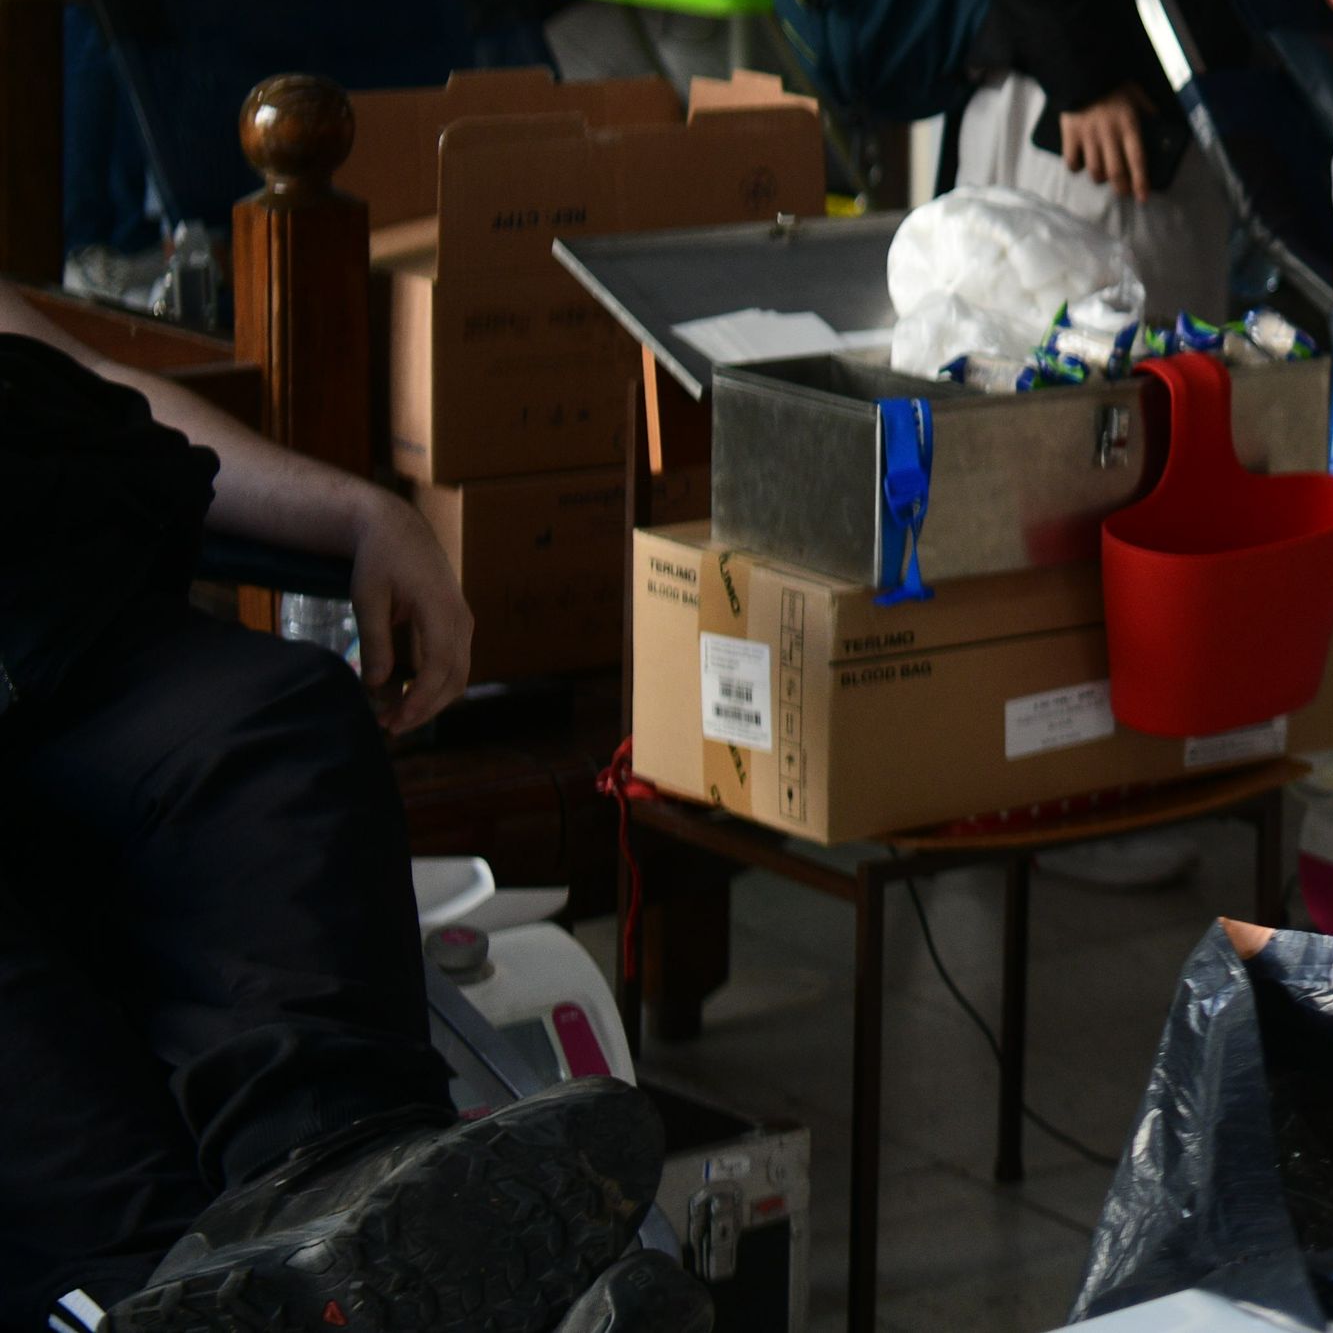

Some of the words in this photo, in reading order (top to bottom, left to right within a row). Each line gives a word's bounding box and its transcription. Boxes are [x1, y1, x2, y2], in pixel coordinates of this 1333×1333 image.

[649, 559, 698, 583] TERUMO
[648, 579, 680, 601] BLOOD
[842, 629, 916, 655] TERUMO
[840, 664, 897, 688] BLOOD
[899, 660, 933, 680] BAG
